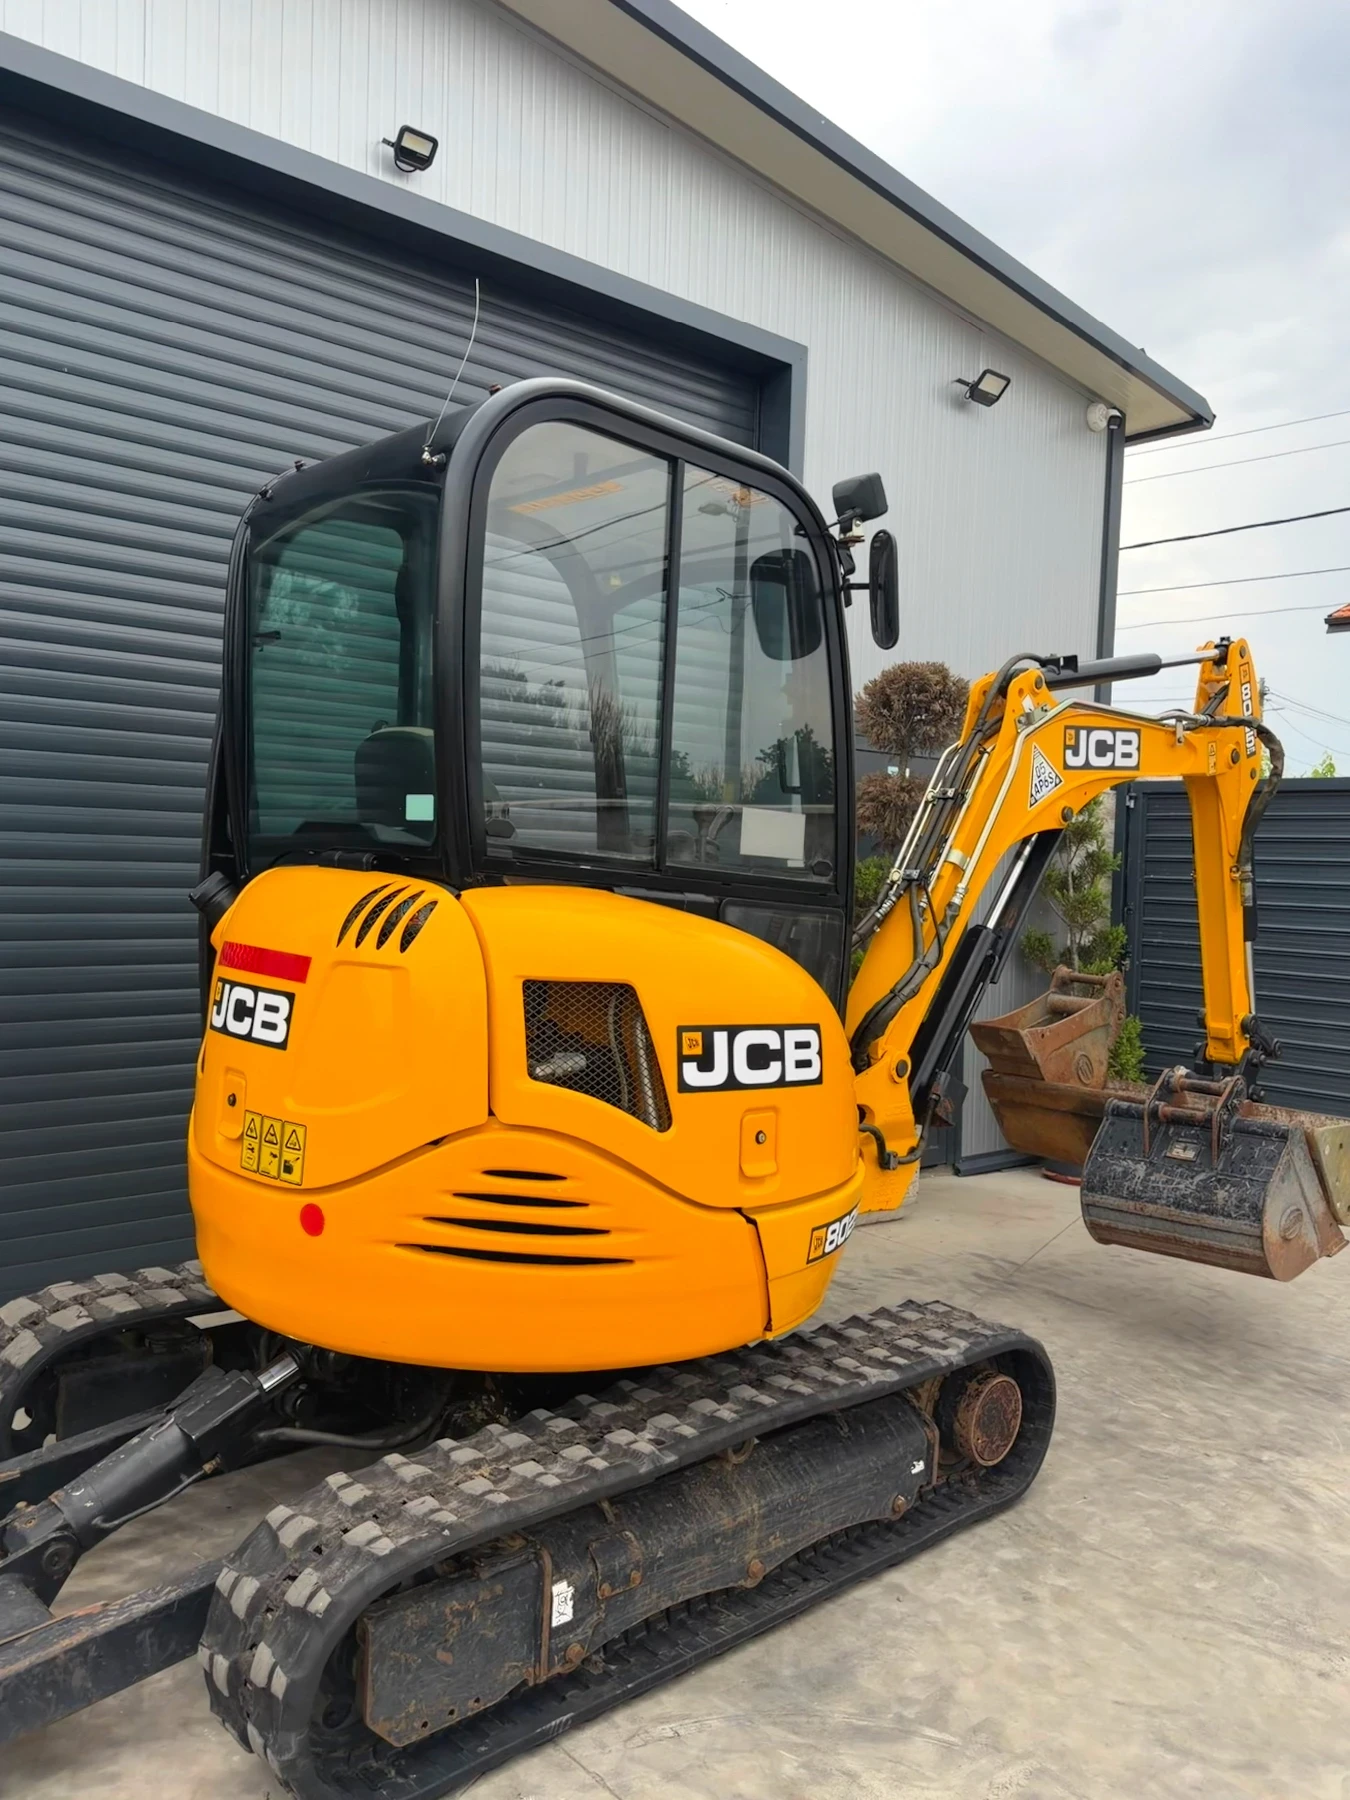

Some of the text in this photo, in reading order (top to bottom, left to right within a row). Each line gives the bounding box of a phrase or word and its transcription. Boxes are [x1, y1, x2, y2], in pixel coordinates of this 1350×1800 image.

[1241, 683, 1255, 749] 805
[1065, 729, 1139, 767] JCB
[211, 983, 290, 1043] JCB
[682, 1029, 821, 1087] JCB
[824, 1207, 859, 1253] 802
